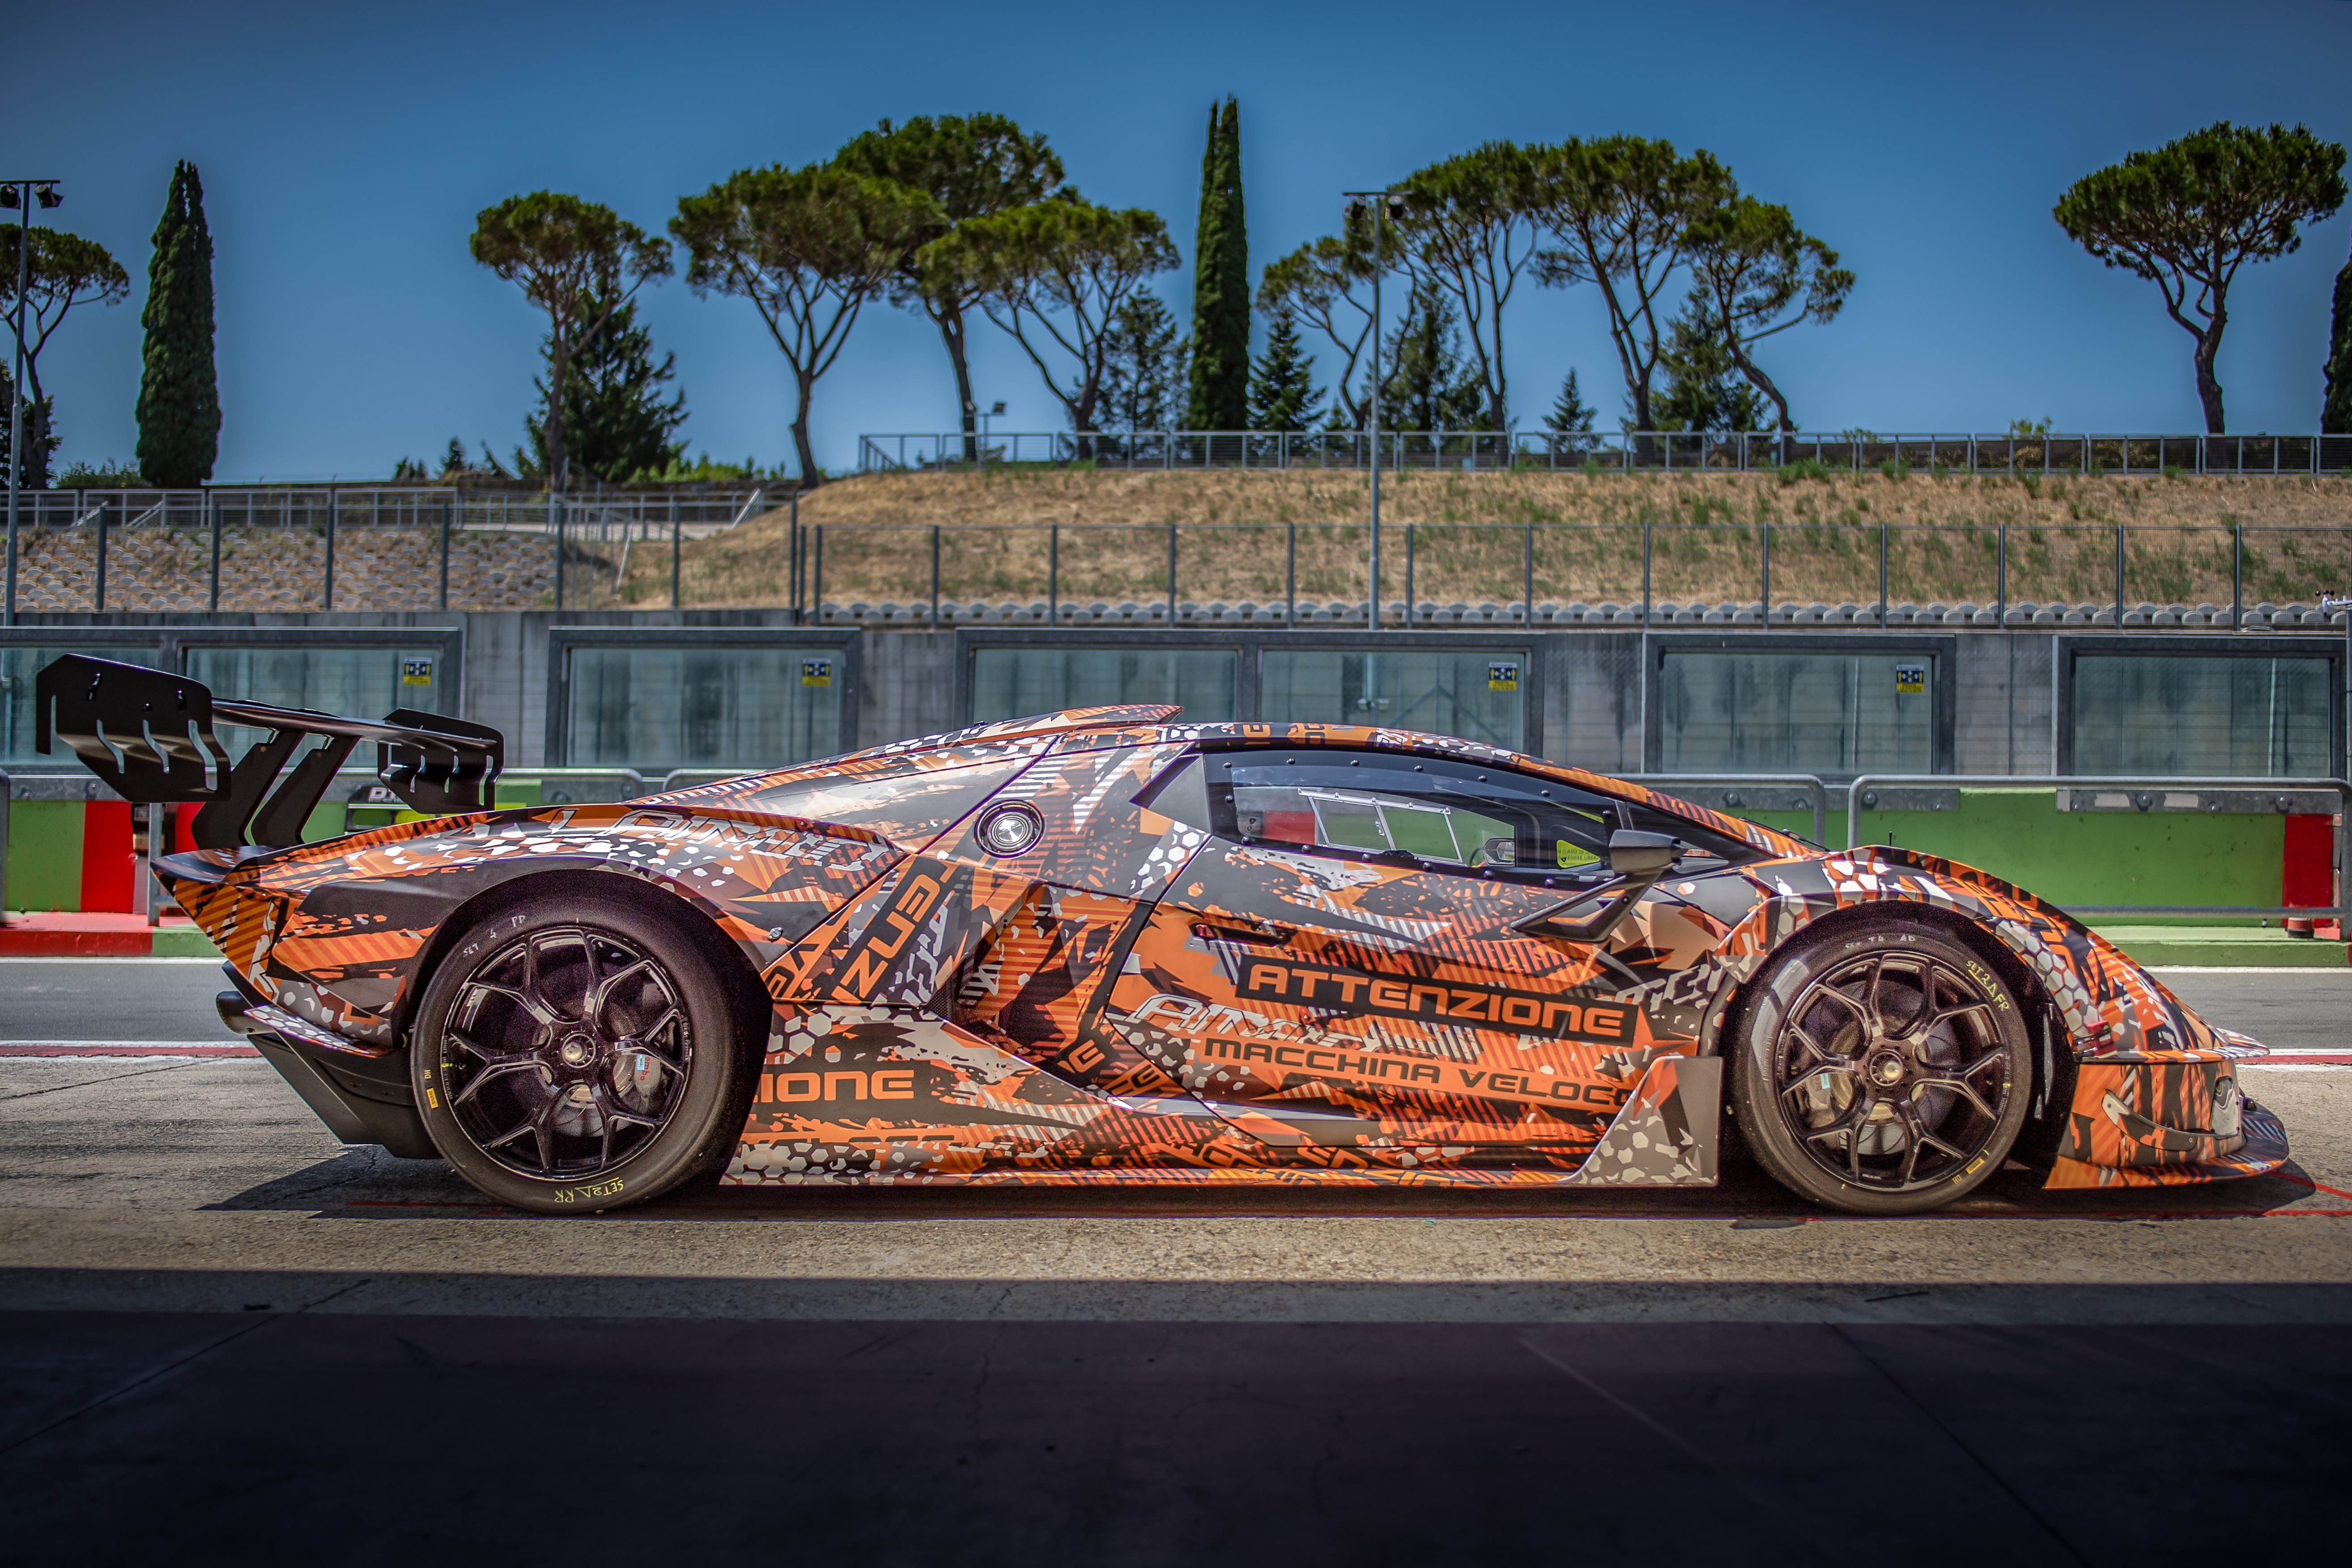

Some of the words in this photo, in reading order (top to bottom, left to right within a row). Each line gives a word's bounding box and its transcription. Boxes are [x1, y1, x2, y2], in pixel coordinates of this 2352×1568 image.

[1248, 963, 1625, 1037] ATTENZIONE
[1204, 1037, 1441, 1084] MACCHINA
[753, 1069, 914, 1103] IONE
